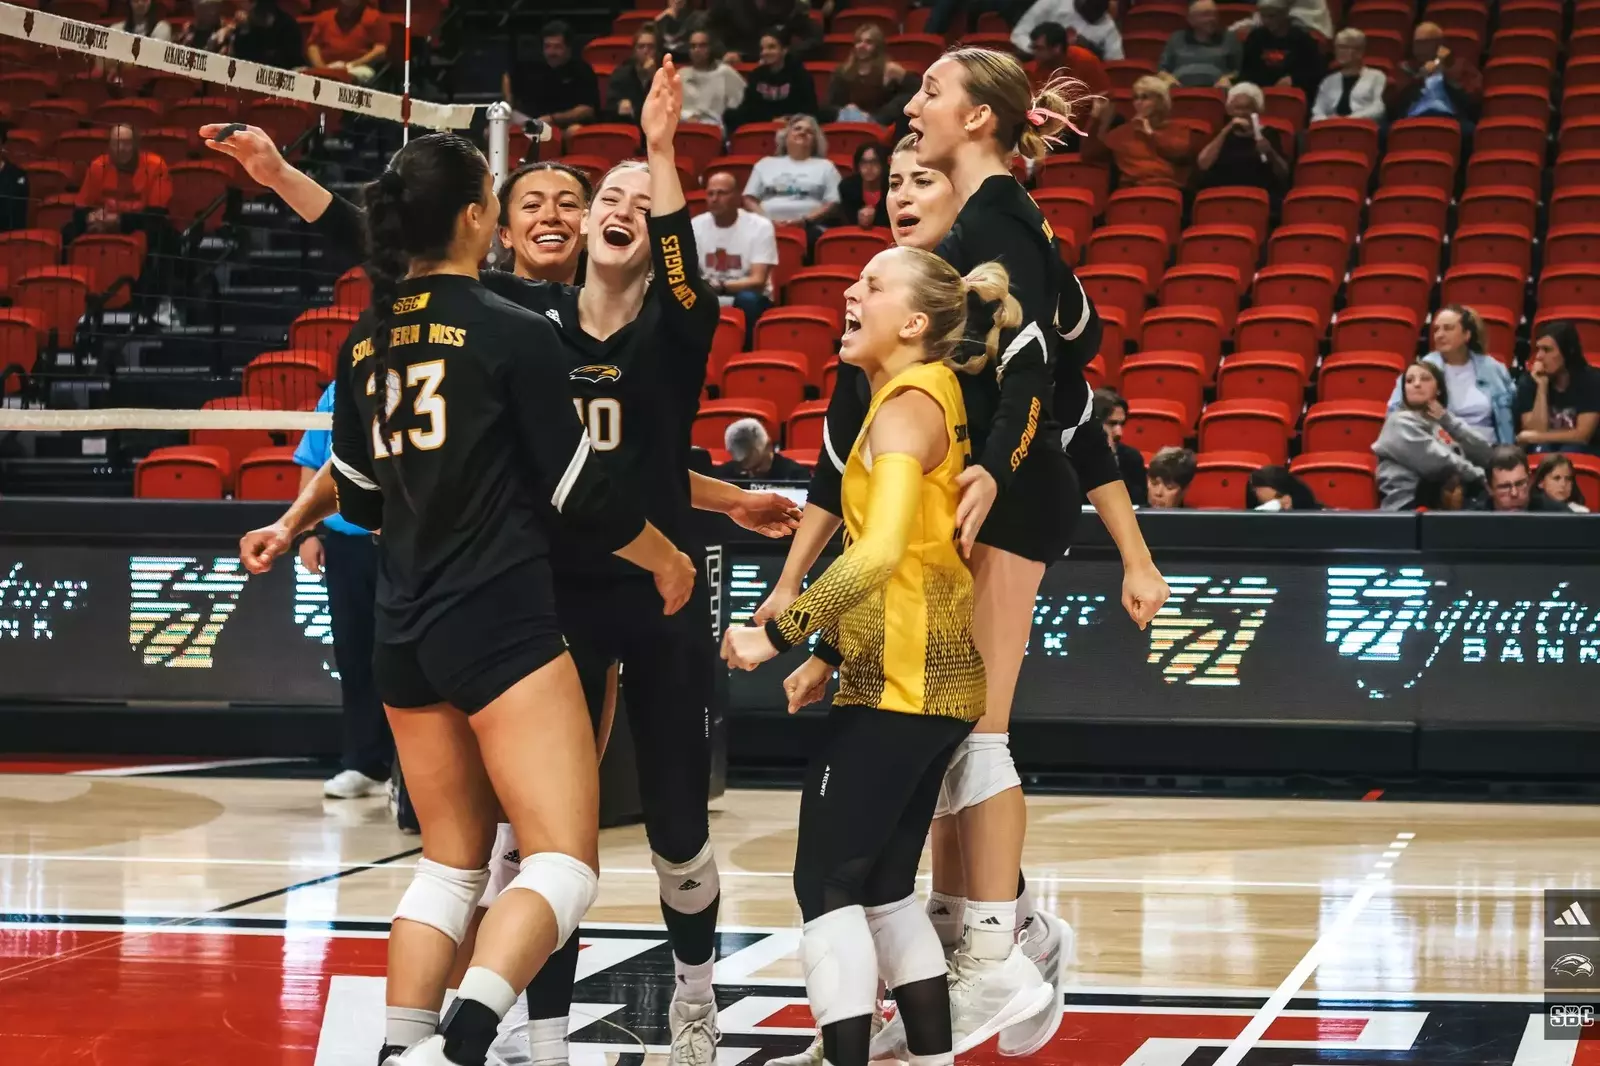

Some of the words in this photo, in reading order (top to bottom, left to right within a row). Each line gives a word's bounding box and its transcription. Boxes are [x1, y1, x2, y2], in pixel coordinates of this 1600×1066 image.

[164, 46, 190, 67] ARKANSAS
[194, 53, 208, 72] STATE
[660, 234, 686, 285] EAGLES
[393, 296, 421, 314] SBC
[352, 324, 421, 367] SOUERN
[428, 323, 467, 347] MISS
[366, 358, 447, 459] 23
